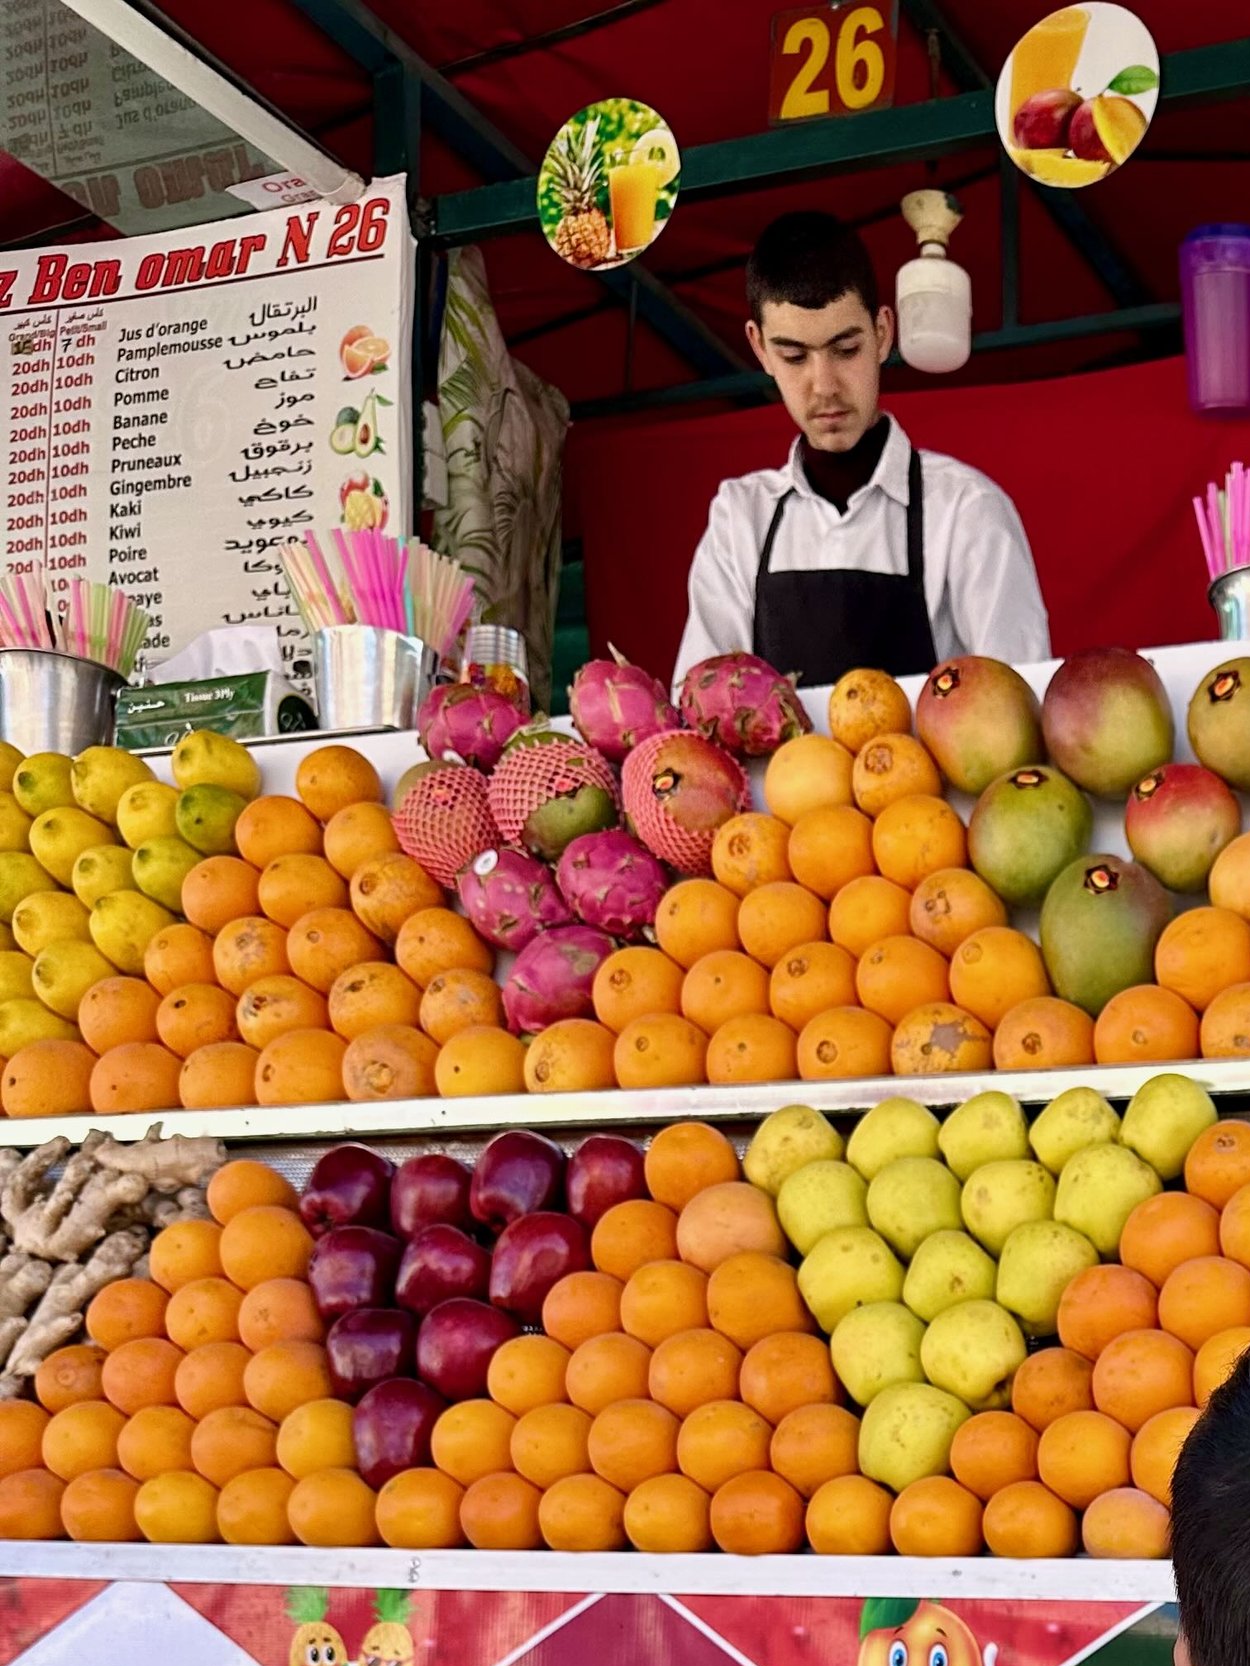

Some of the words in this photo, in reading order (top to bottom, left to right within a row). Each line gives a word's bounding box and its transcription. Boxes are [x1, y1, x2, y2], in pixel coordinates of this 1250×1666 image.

[780, 6, 885, 119] 26
[28, 253, 123, 305] Ben
[134, 233, 267, 291] omar
[276, 210, 320, 268] N
[327, 197, 390, 259] 26
[248, 295, 317, 327] البرتقال
[118, 327, 142, 343] Jus
[146, 317, 208, 338] d'orange
[76, 334, 96, 348] dh
[117, 334, 222, 362] Pamplemousse
[56, 353, 95, 370] 10dh
[223, 345, 316, 370] حامض
[12, 361, 50, 376] 20dh
[115, 366, 159, 383] Citron
[54, 373, 93, 390] 10dh
[254, 368, 317, 389] تفاح
[11, 380, 49, 397] 20dh
[114, 388, 169, 407] Pomme
[53, 397, 92, 414] 10dh
[274, 392, 315, 410] موز
[10, 402, 47, 420] 20dh
[53, 419, 91, 437] 10dh
[113, 411, 168, 430] Banane
[253, 414, 315, 435] خوخ
[9, 426, 47, 443] 20dh
[112, 433, 157, 451] Peche
[9, 448, 46, 464] 20dh
[52, 441, 90, 458] 10dh
[240, 439, 314, 460] برقوق
[51, 462, 89, 479] 10dh
[111, 454, 182, 473] Pruneaux
[228, 459, 312, 482] زنجبيل
[8, 468, 45, 485] 20dh
[110, 474, 192, 496] Gingembre
[7, 491, 44, 507] 20dh
[50, 484, 87, 501] 10dh
[238, 484, 314, 507] كاكي
[50, 508, 87, 525] 10dh
[110, 500, 142, 518] Kaki
[7, 515, 43, 531] 20dh
[246, 509, 314, 530] كيوي
[49, 531, 87, 549] 10dh
[109, 522, 141, 541] Kiwi
[6, 537, 43, 554] 20dh
[108, 546, 147, 563] Poire
[6, 560, 34, 575] 20d
[49, 554, 87, 571] 10dh
[108, 567, 159, 585] Avocat
